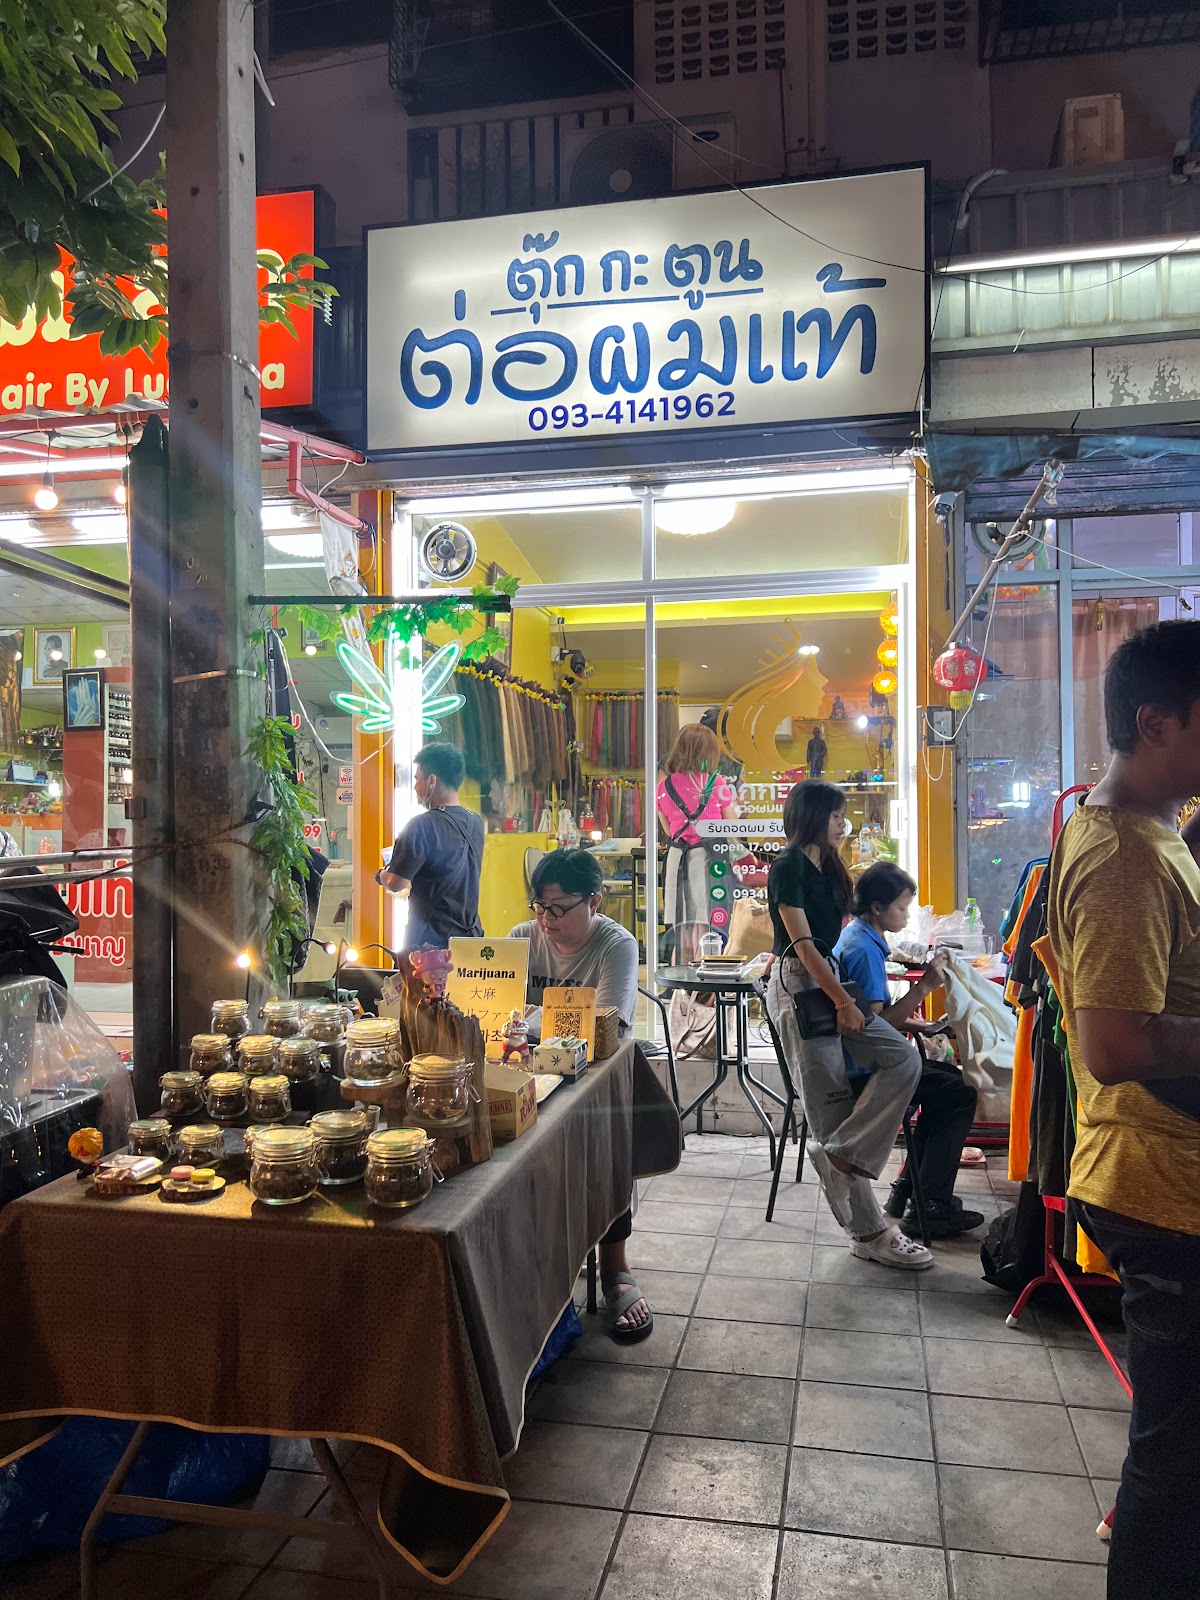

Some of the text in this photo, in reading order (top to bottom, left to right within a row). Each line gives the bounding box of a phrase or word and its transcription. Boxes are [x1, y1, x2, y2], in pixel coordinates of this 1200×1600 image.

[66, 372, 110, 408] By
[527, 391, 737, 430] 093-4141962
[713, 843, 744, 854] open
[457, 967, 516, 980] Marijuana
[470, 986, 496, 1001] 大麻
[520, 1095, 535, 1123] RAW
